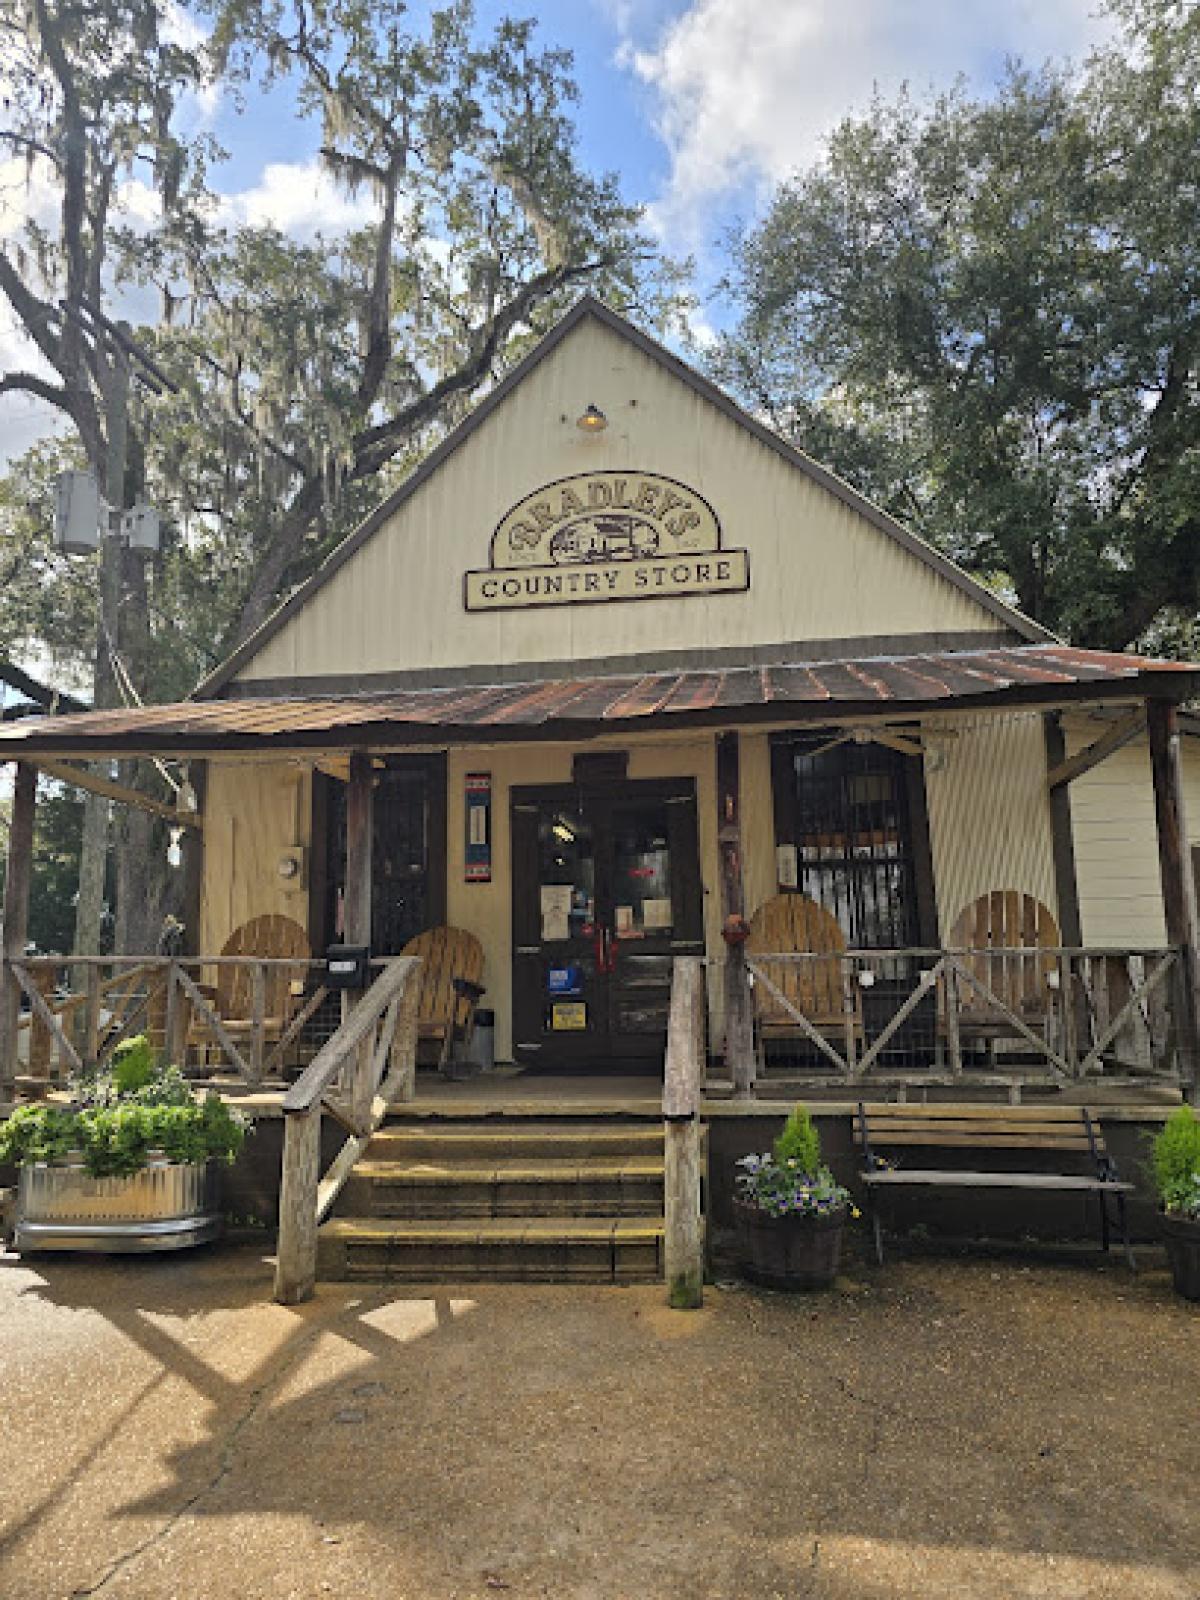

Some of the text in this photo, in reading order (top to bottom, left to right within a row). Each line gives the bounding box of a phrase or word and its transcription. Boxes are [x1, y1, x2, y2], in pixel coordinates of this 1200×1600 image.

[508, 479, 701, 551] BRADLEY'S
[481, 561, 730, 598] COUNTRY STORE
